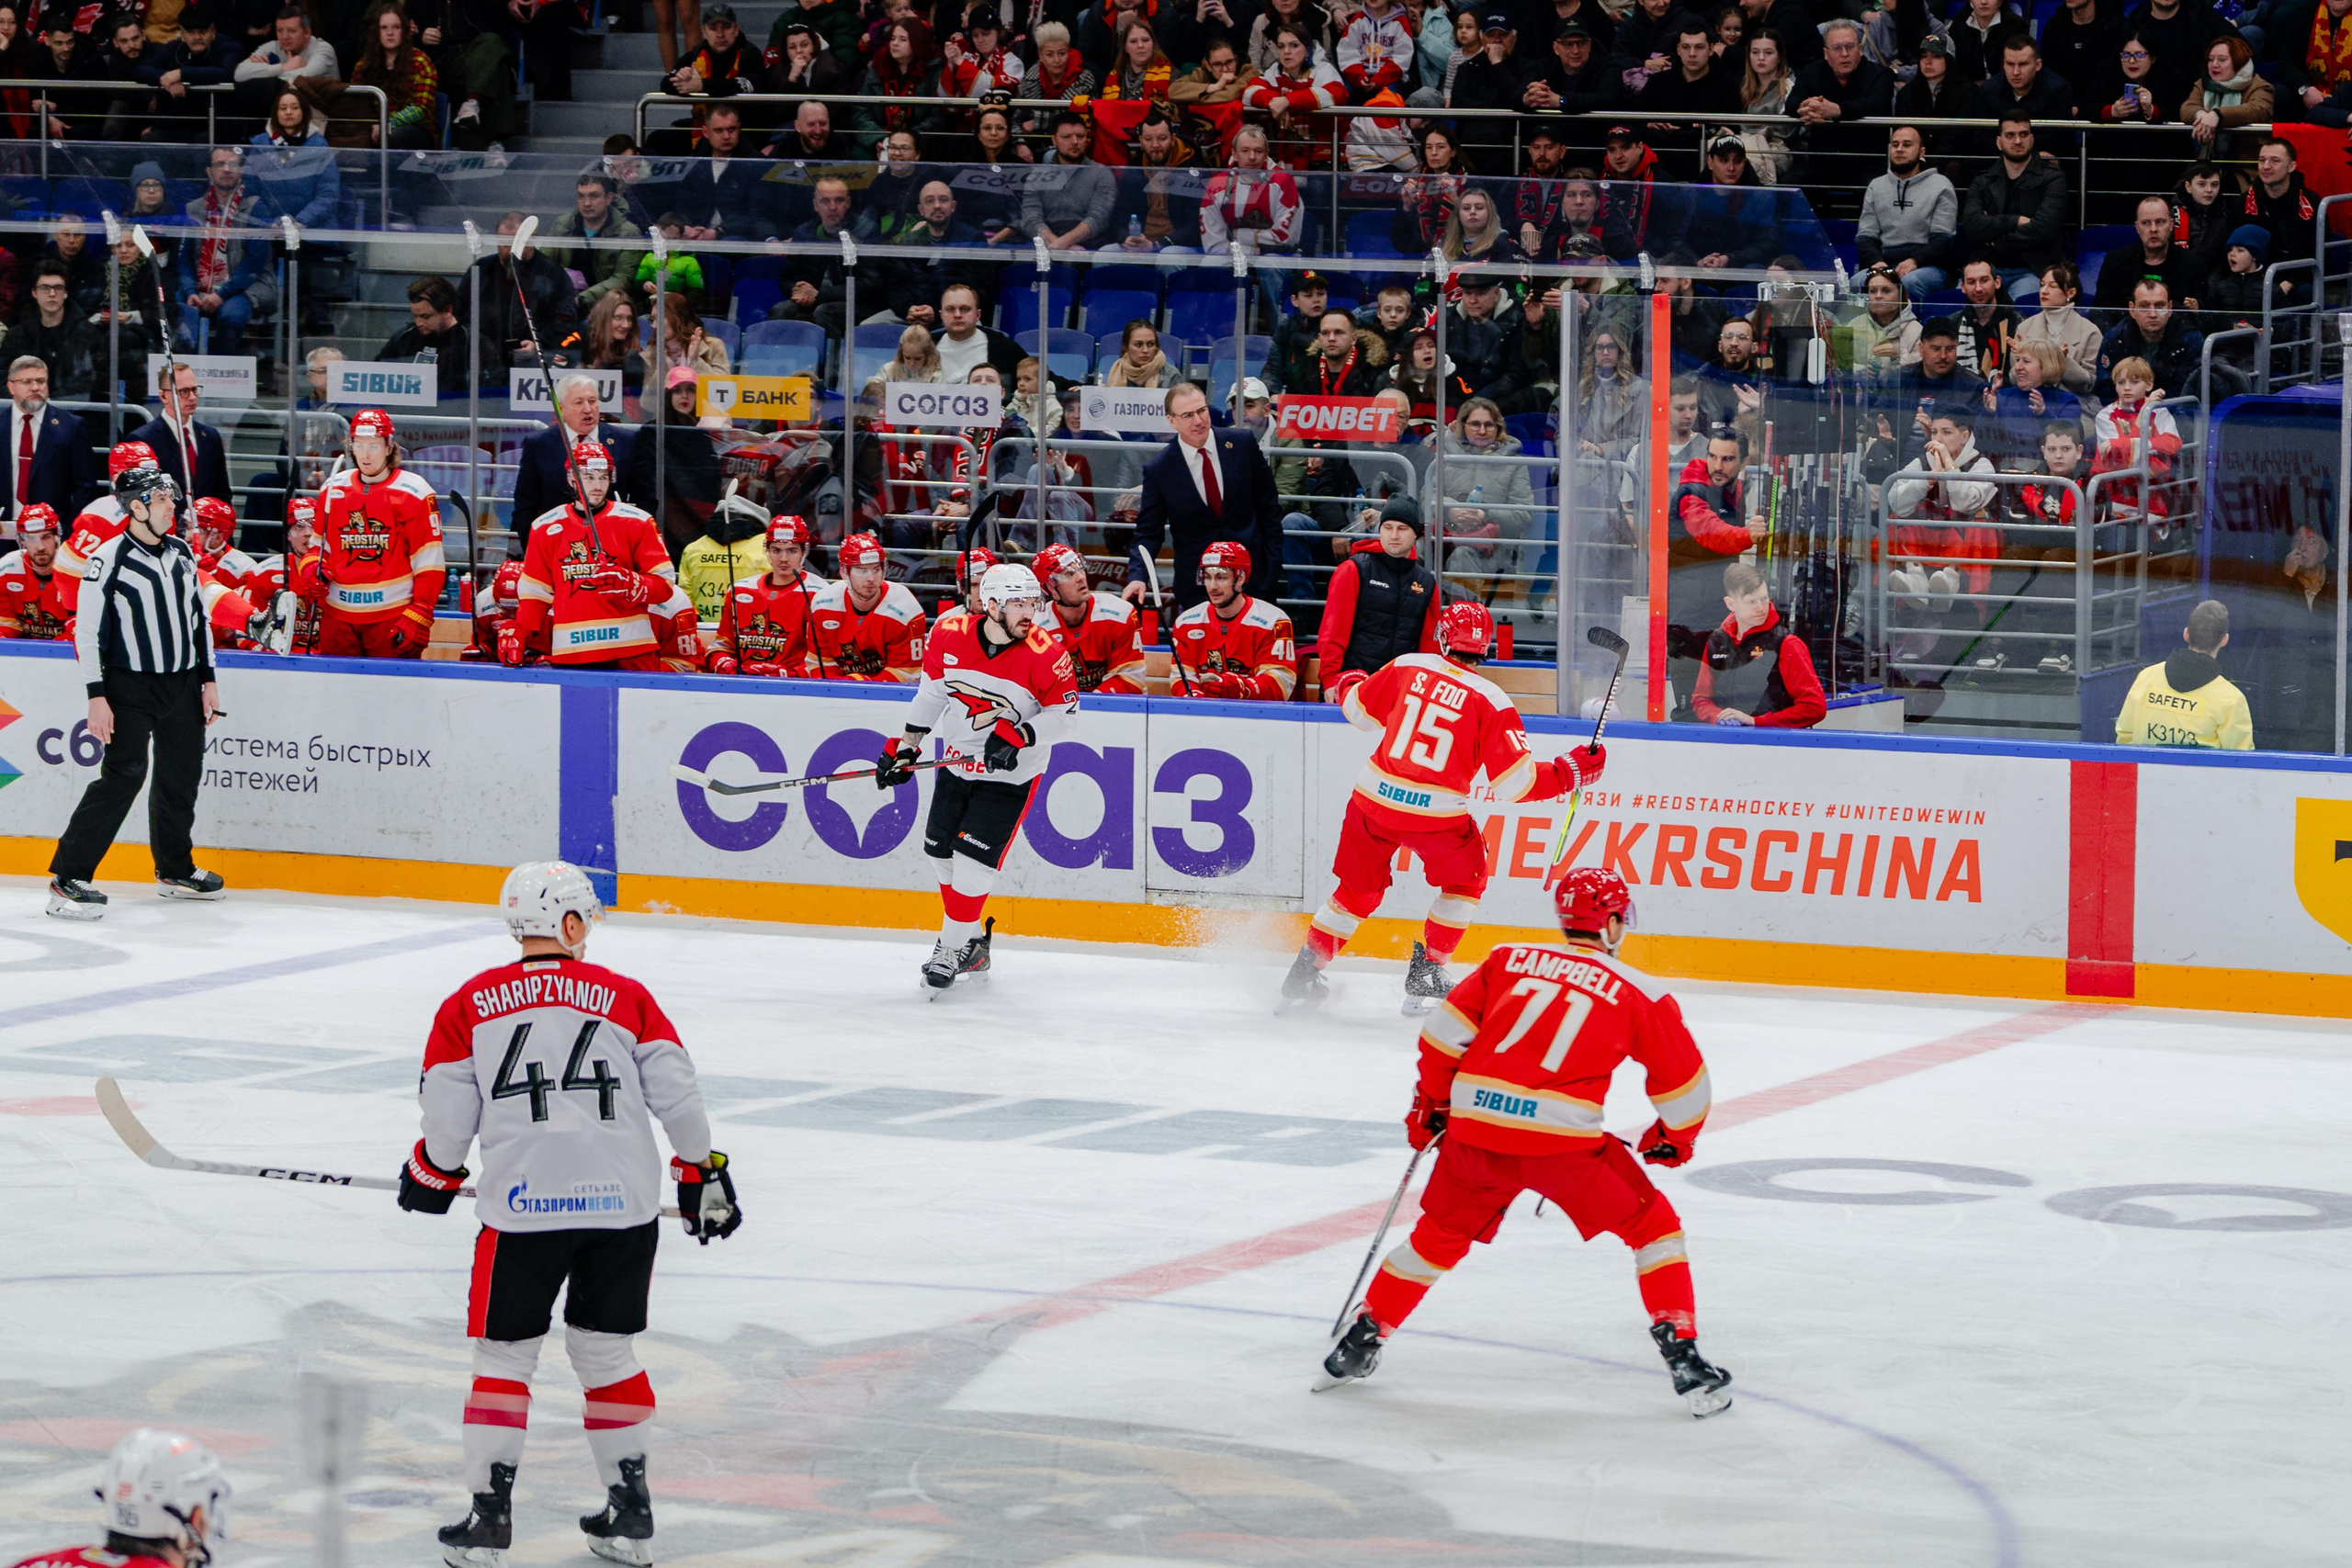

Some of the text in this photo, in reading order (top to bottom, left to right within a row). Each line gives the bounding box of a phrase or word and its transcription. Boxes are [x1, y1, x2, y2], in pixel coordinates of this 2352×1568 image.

[342, 372, 423, 395] SIBUR
[516, 378, 616, 402] KHU
[742, 389, 797, 405] БАНК
[898, 393, 989, 416] согаз
[1114, 403, 1167, 417] ГАЗПРОМ
[1279, 404, 1396, 431] FONBET
[74, 529, 102, 556] 32
[700, 554, 742, 564] SAFETY
[561, 564, 615, 582] REDST
[339, 590, 383, 603] SIBUR
[698, 604, 726, 617] SAF
[570, 627, 619, 644] SIBUR
[1471, 627, 1483, 638] 15
[1271, 639, 1295, 661] 40
[1410, 671, 1468, 711] S. FOO
[2148, 692, 2199, 712] SAFETY
[37, 718, 104, 767] сб
[1387, 693, 1464, 773] 15
[1505, 729, 1532, 751] 15
[202, 734, 432, 772] истема быстрых
[200, 766, 319, 794] латежей
[779, 776, 828, 789] CCM
[676, 721, 1256, 878] соаз
[1378, 781, 1431, 808] SIBUR
[1633, 794, 1815, 818] #REDSTARHOCKEY
[1826, 803, 1986, 826] #UNITEDWEWIN
[1505, 948, 1624, 1006] CAMPBELL
[472, 974, 616, 1019] SHARIPZYANOV
[1494, 976, 1594, 1074] 71
[491, 1019, 622, 1123] 44
[1474, 1089, 1539, 1118] SIBUR
[258, 1168, 353, 1186] CCM
[573, 1183, 622, 1193] СЕТЬ АЗС
[528, 1195, 625, 1213] ГАЗПРОМНЕФТЬ
